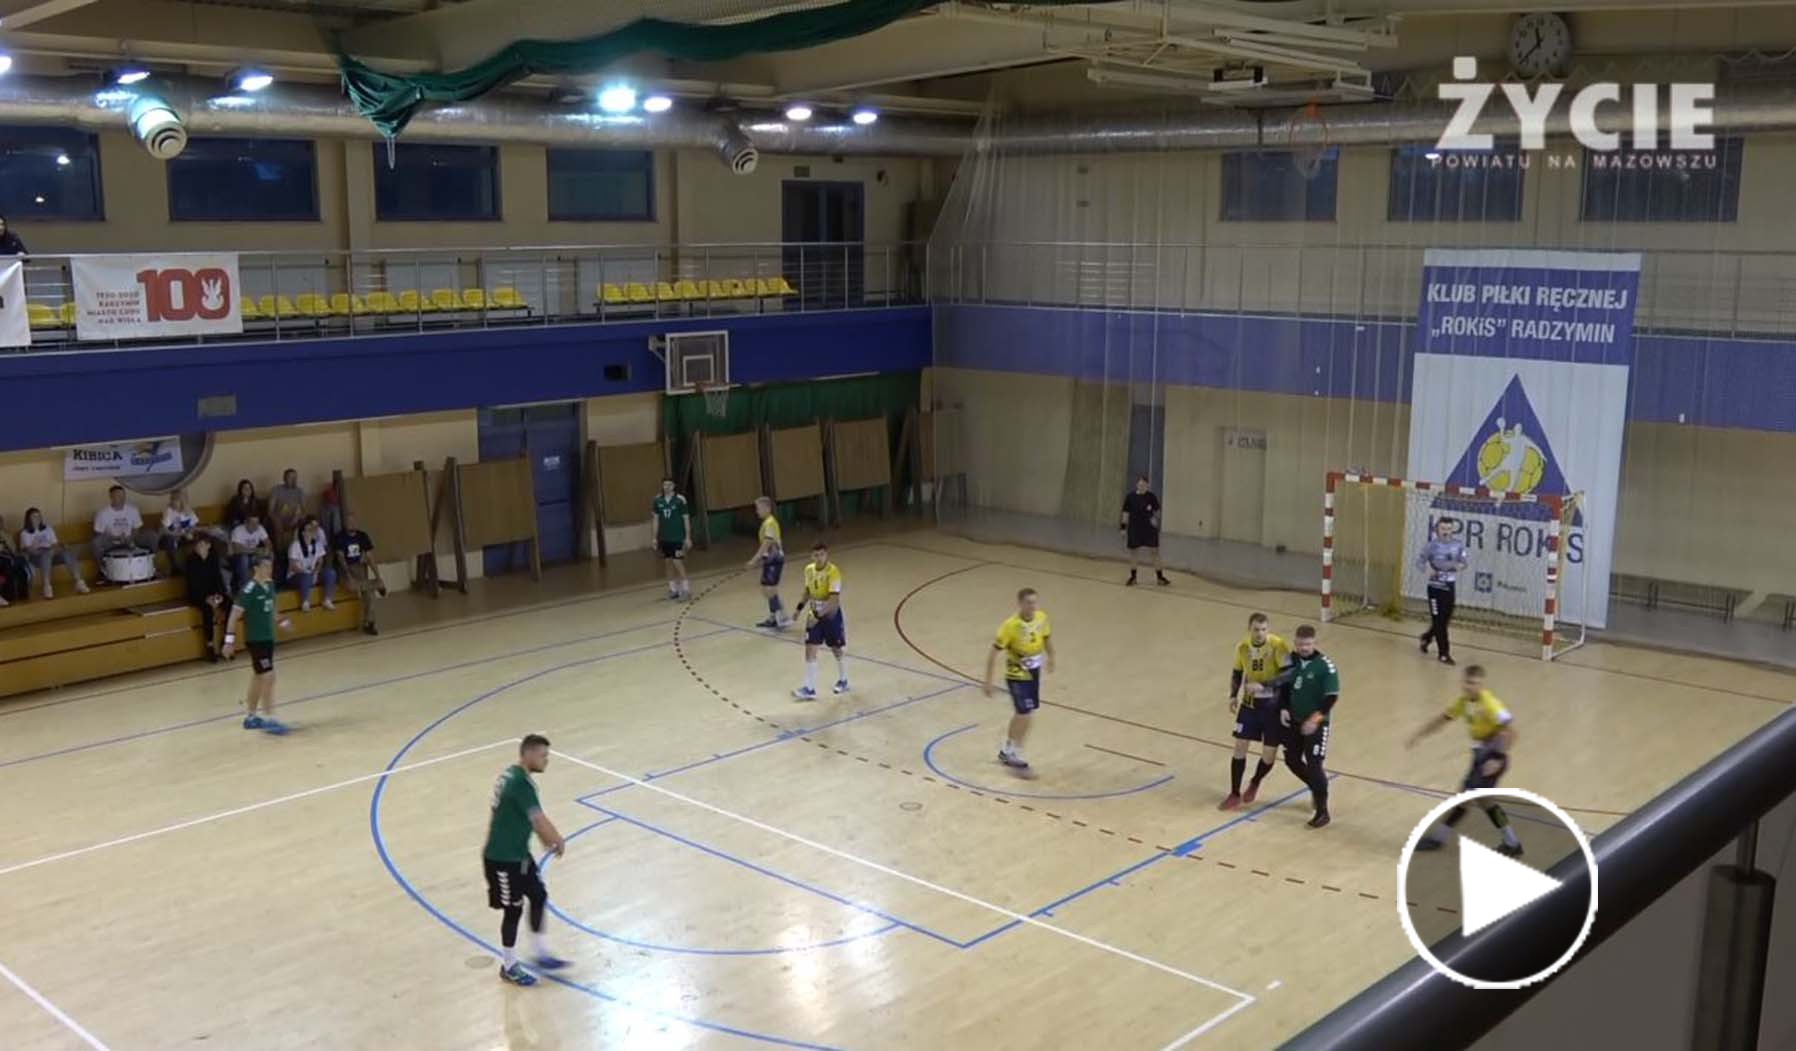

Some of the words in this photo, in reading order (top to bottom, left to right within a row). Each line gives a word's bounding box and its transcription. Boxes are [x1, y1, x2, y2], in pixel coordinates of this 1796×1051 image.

[136, 268, 231, 322] 100
[1427, 283, 1476, 303] KLUB
[1481, 284, 1531, 306] PIŁKI
[1536, 286, 1629, 312] RĘCZNEJ
[1511, 319, 1615, 344] RADZYMIN
[1496, 522, 1584, 564] ROKS
